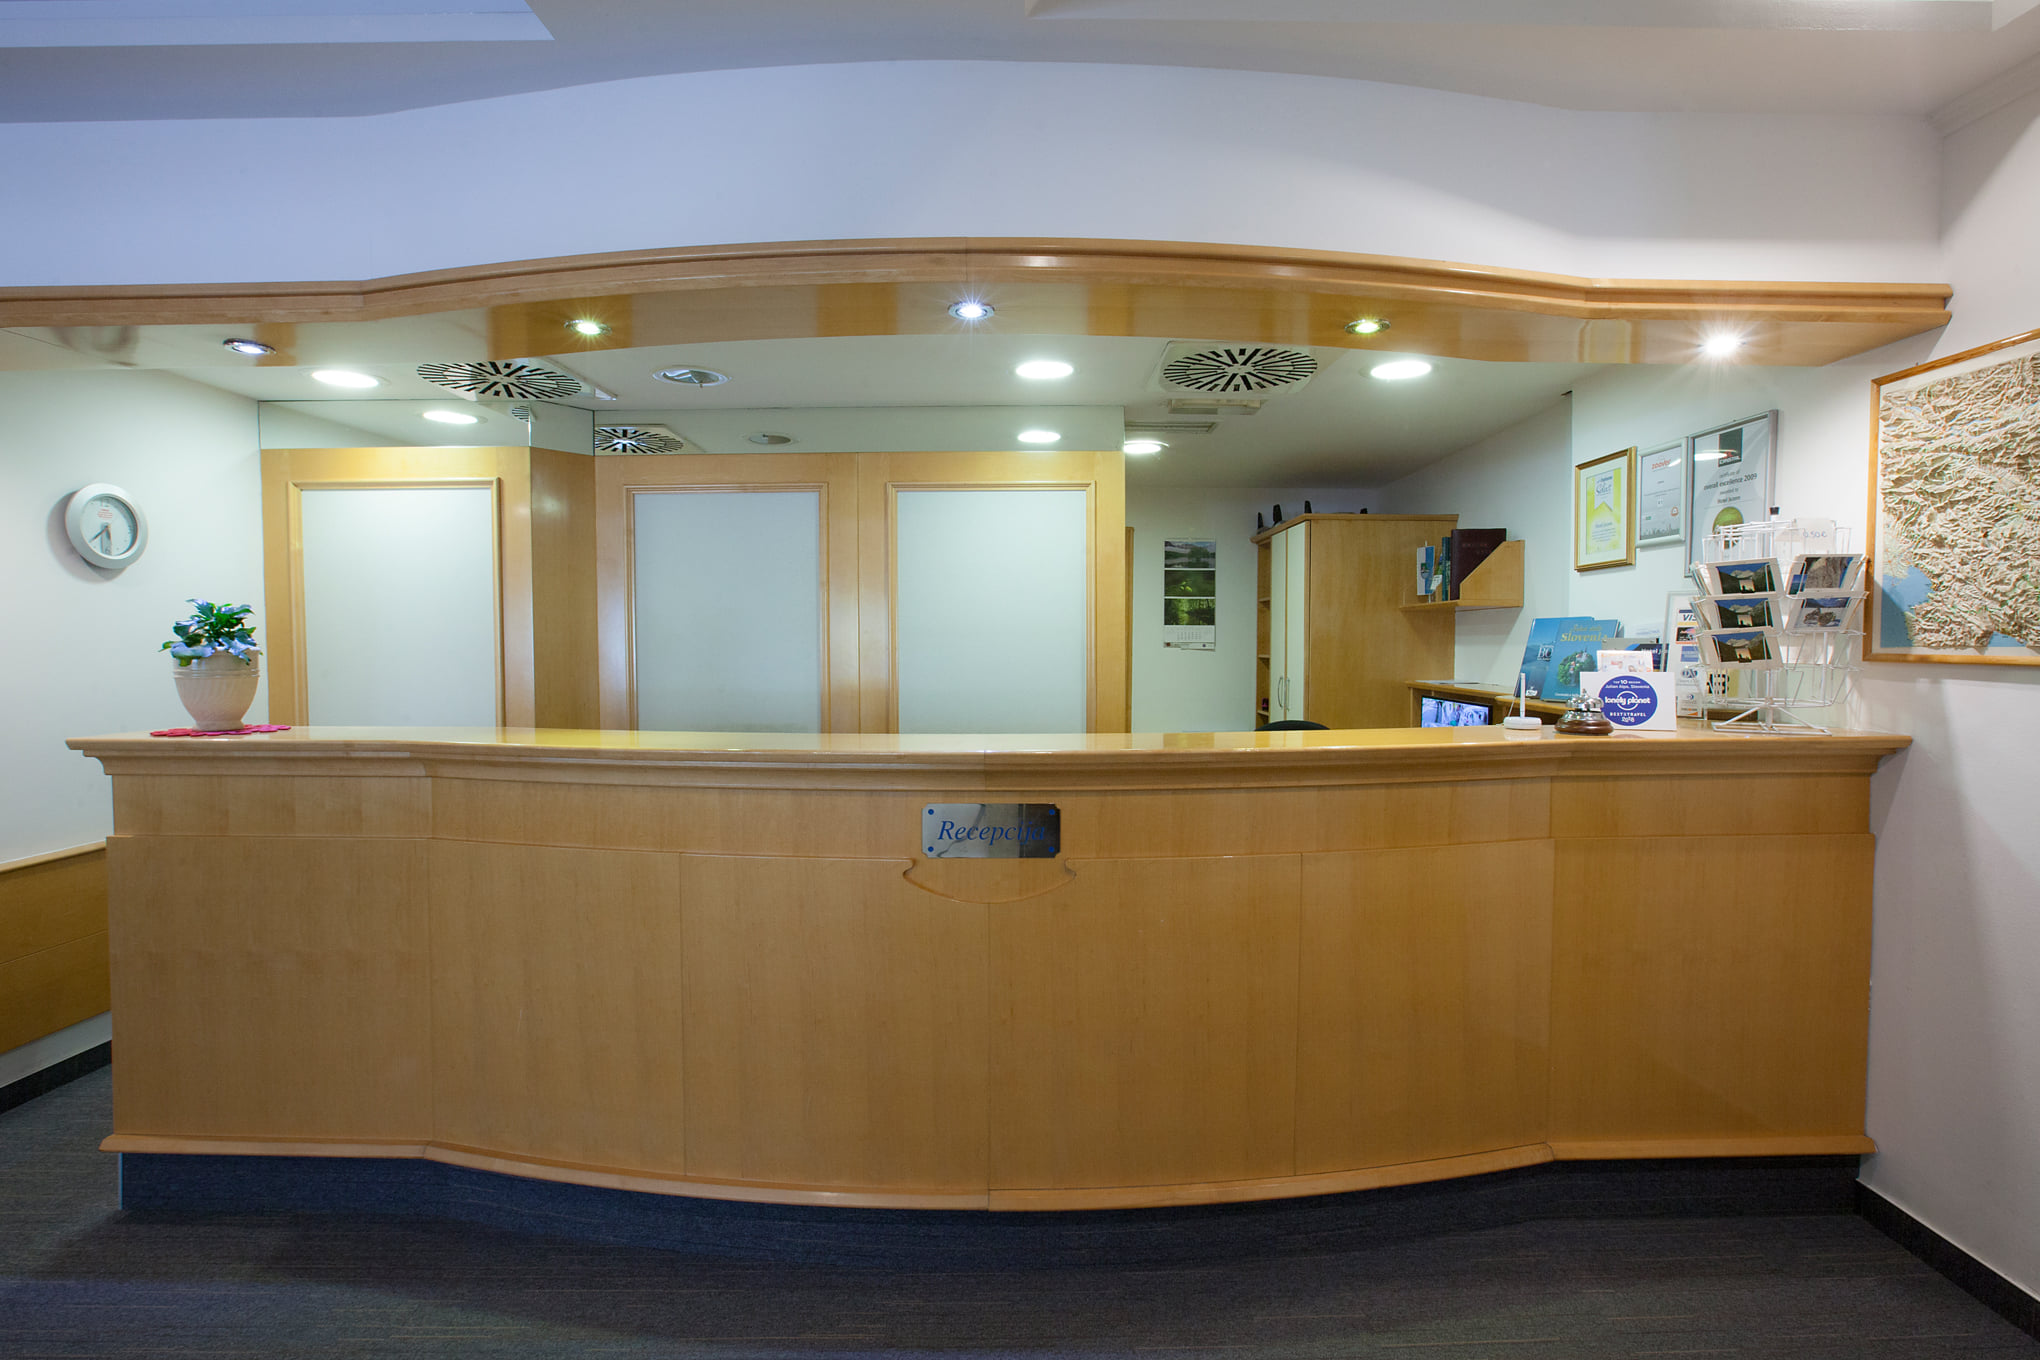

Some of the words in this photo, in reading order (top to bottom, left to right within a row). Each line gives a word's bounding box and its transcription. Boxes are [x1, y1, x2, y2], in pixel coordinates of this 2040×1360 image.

[1743, 472, 1758, 481] 2009
[1604, 696, 1627, 706] lonely
[1627, 696, 1651, 705] planet
[937, 820, 1046, 846] Recepcija
